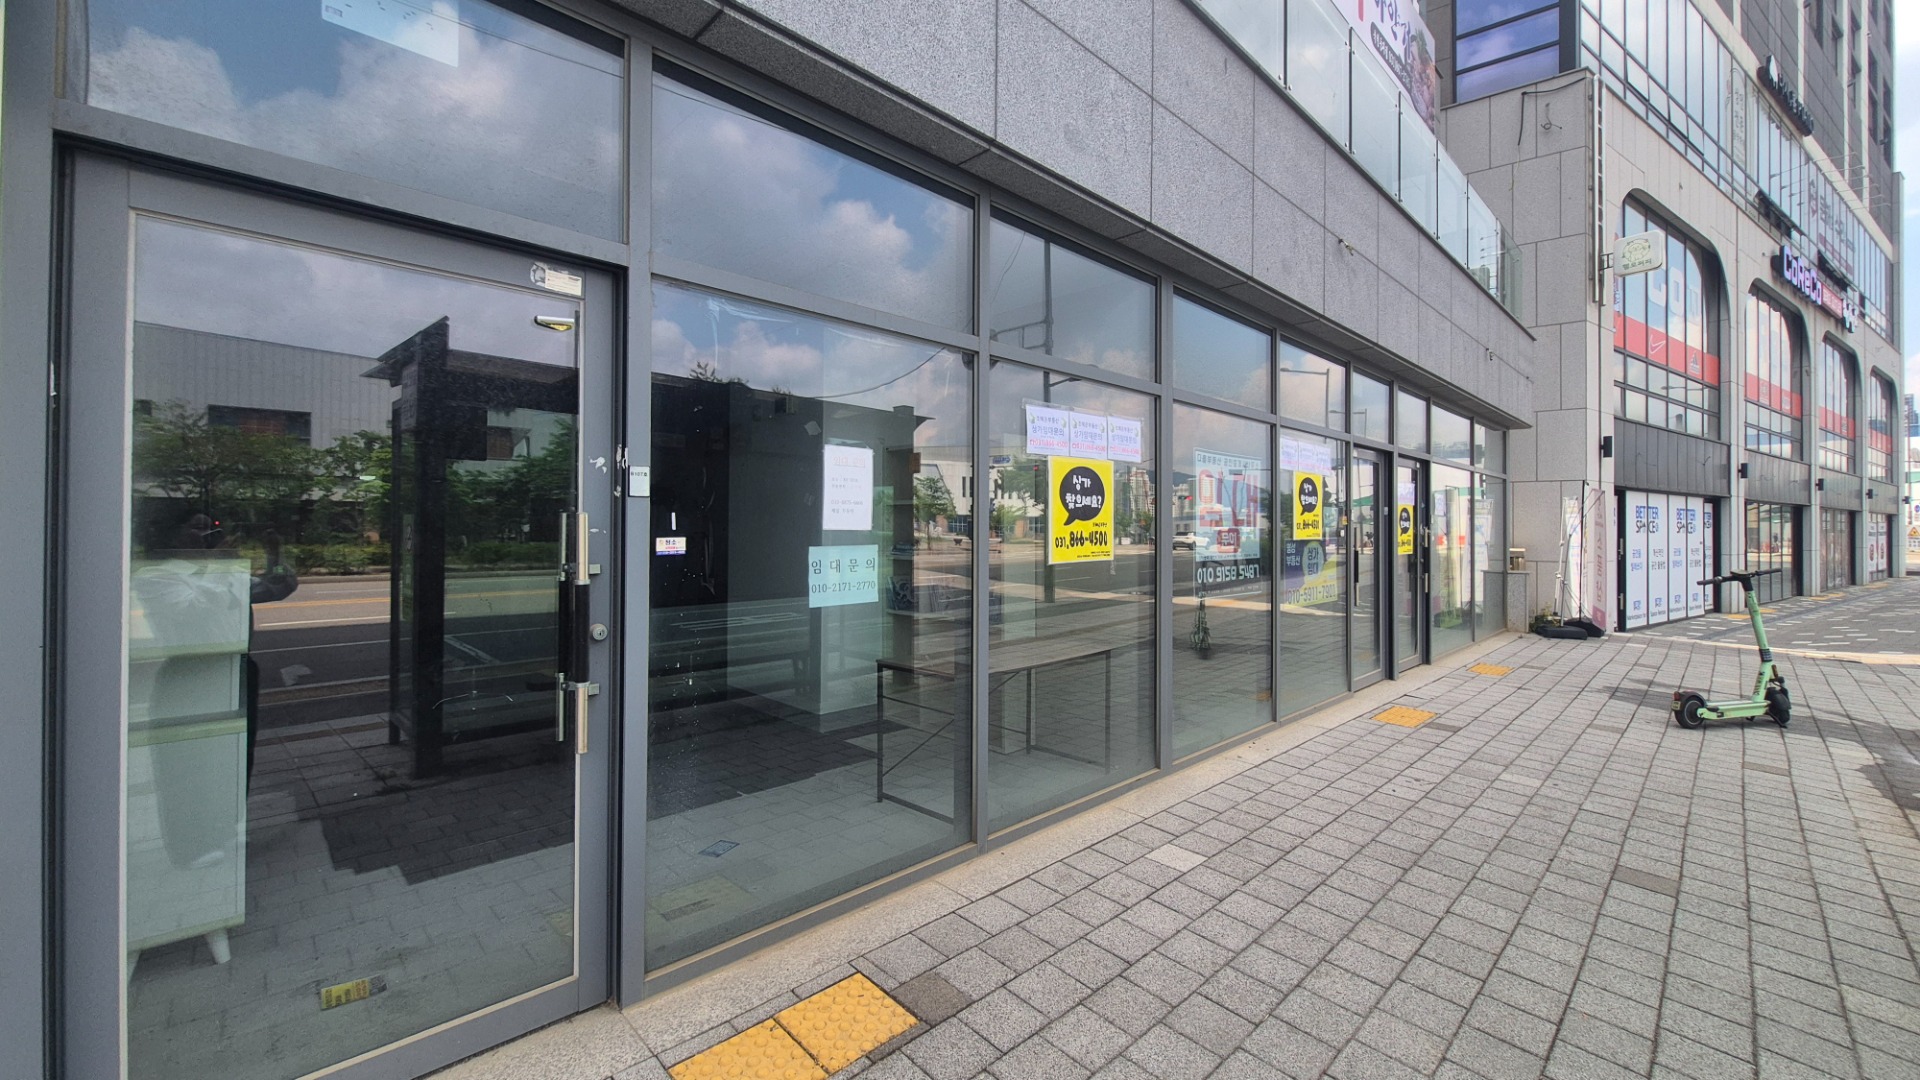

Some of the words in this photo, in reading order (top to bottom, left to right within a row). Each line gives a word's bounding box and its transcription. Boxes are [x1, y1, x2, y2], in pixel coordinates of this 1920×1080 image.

[1072, 474, 1092, 491] 상가
[1065, 492, 1102, 510] 찾으세요?
[1198, 468, 1259, 529] 임대
[1196, 567, 1215, 584] 010
[1216, 565, 1237, 582] 9158
[1238, 563, 1260, 579] 5487
[811, 580, 876, 594] 010-2171-2770
